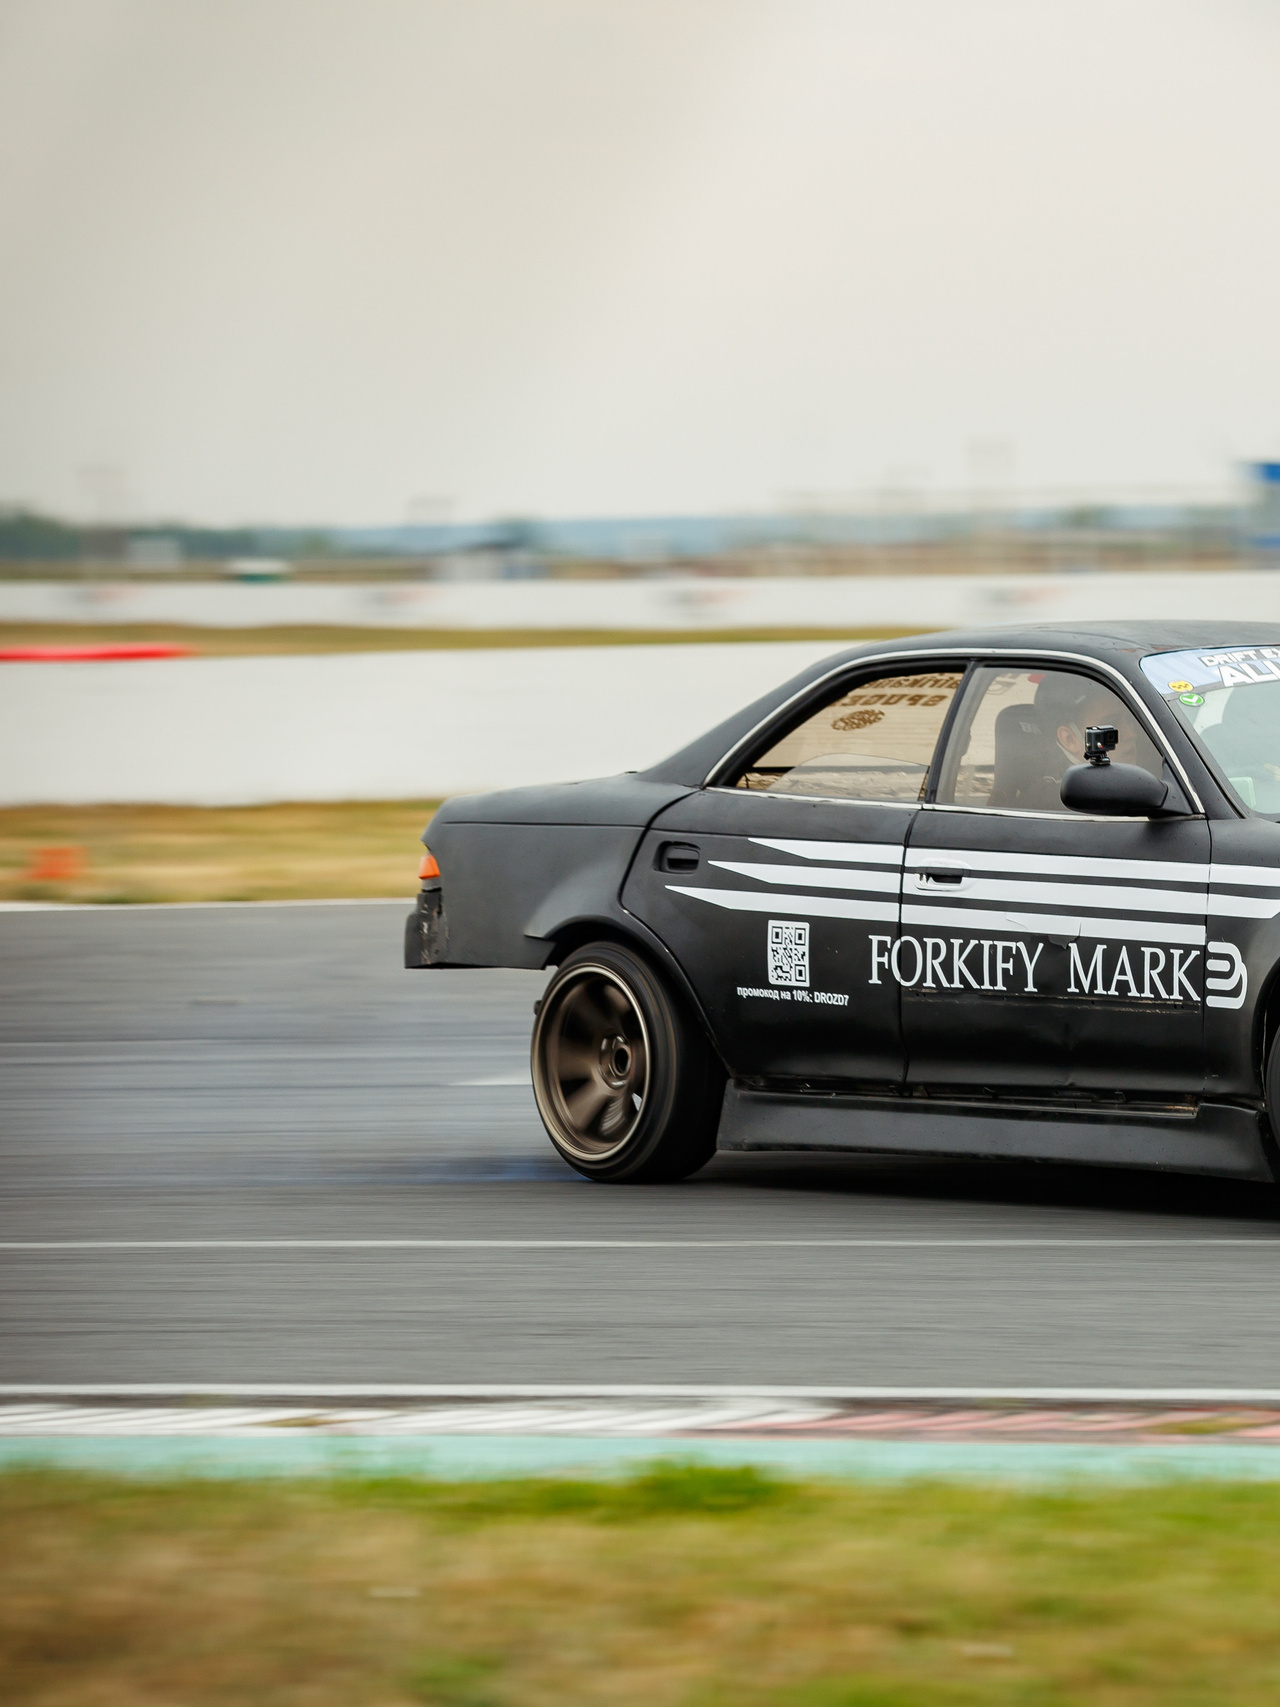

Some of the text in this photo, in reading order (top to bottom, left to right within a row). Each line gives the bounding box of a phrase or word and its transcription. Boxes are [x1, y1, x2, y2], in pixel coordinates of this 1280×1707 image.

[1200, 650, 1260, 667] DRIFT
[868, 934, 1044, 993] FORKIFY
[1067, 942, 1201, 1001] MARK
[736, 987, 850, 1006] промокод на 10%: DROZD7
